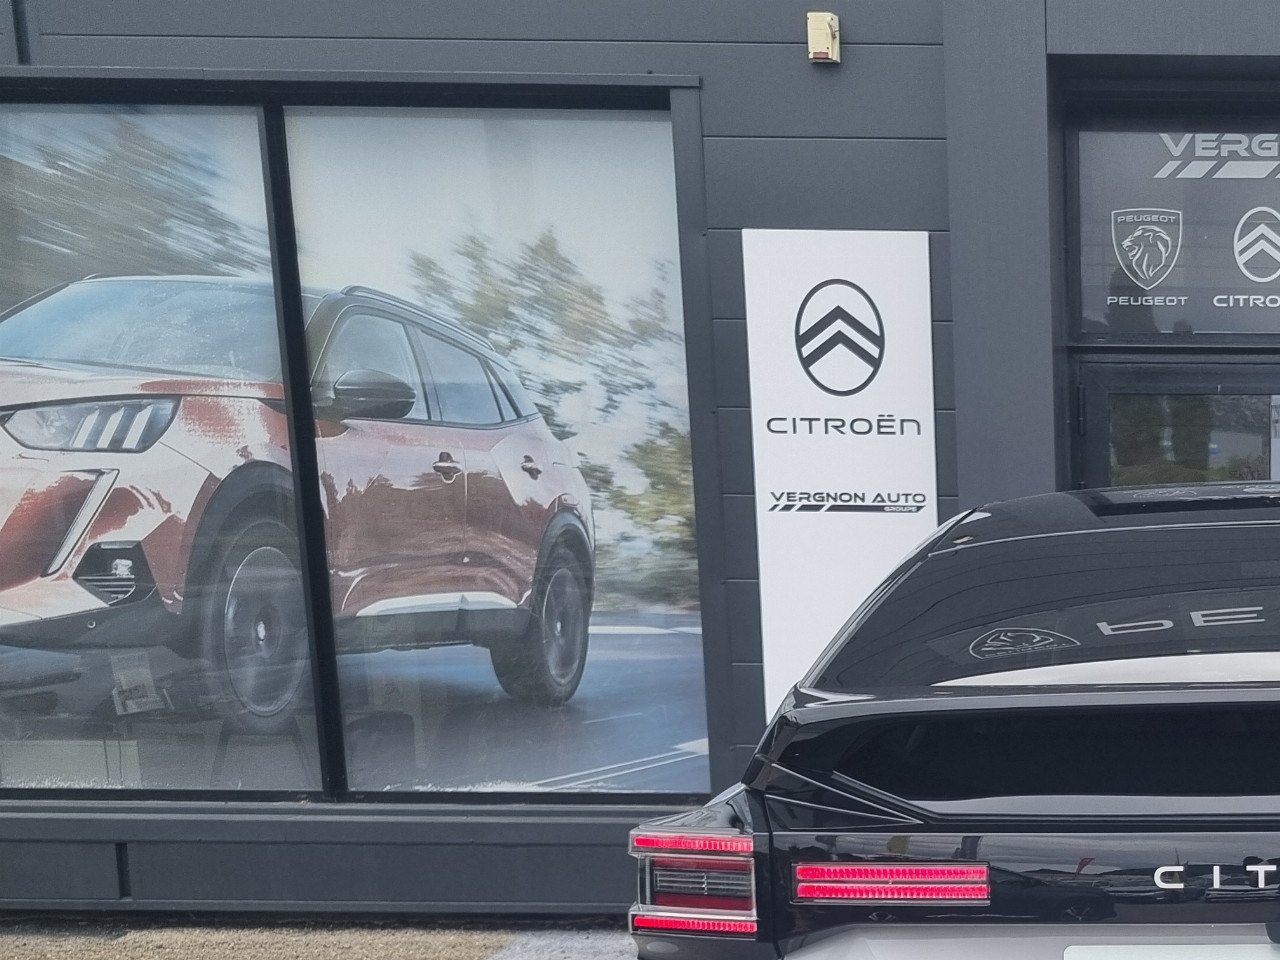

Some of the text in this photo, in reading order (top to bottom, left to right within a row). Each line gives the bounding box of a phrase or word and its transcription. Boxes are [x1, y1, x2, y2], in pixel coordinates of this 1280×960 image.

[1117, 214, 1177, 223] PEUGEOT
[1106, 296, 1189, 306] PEUGEOT
[766, 414, 921, 436] CITROËN
[770, 491, 927, 504] VERGNON AUTO
